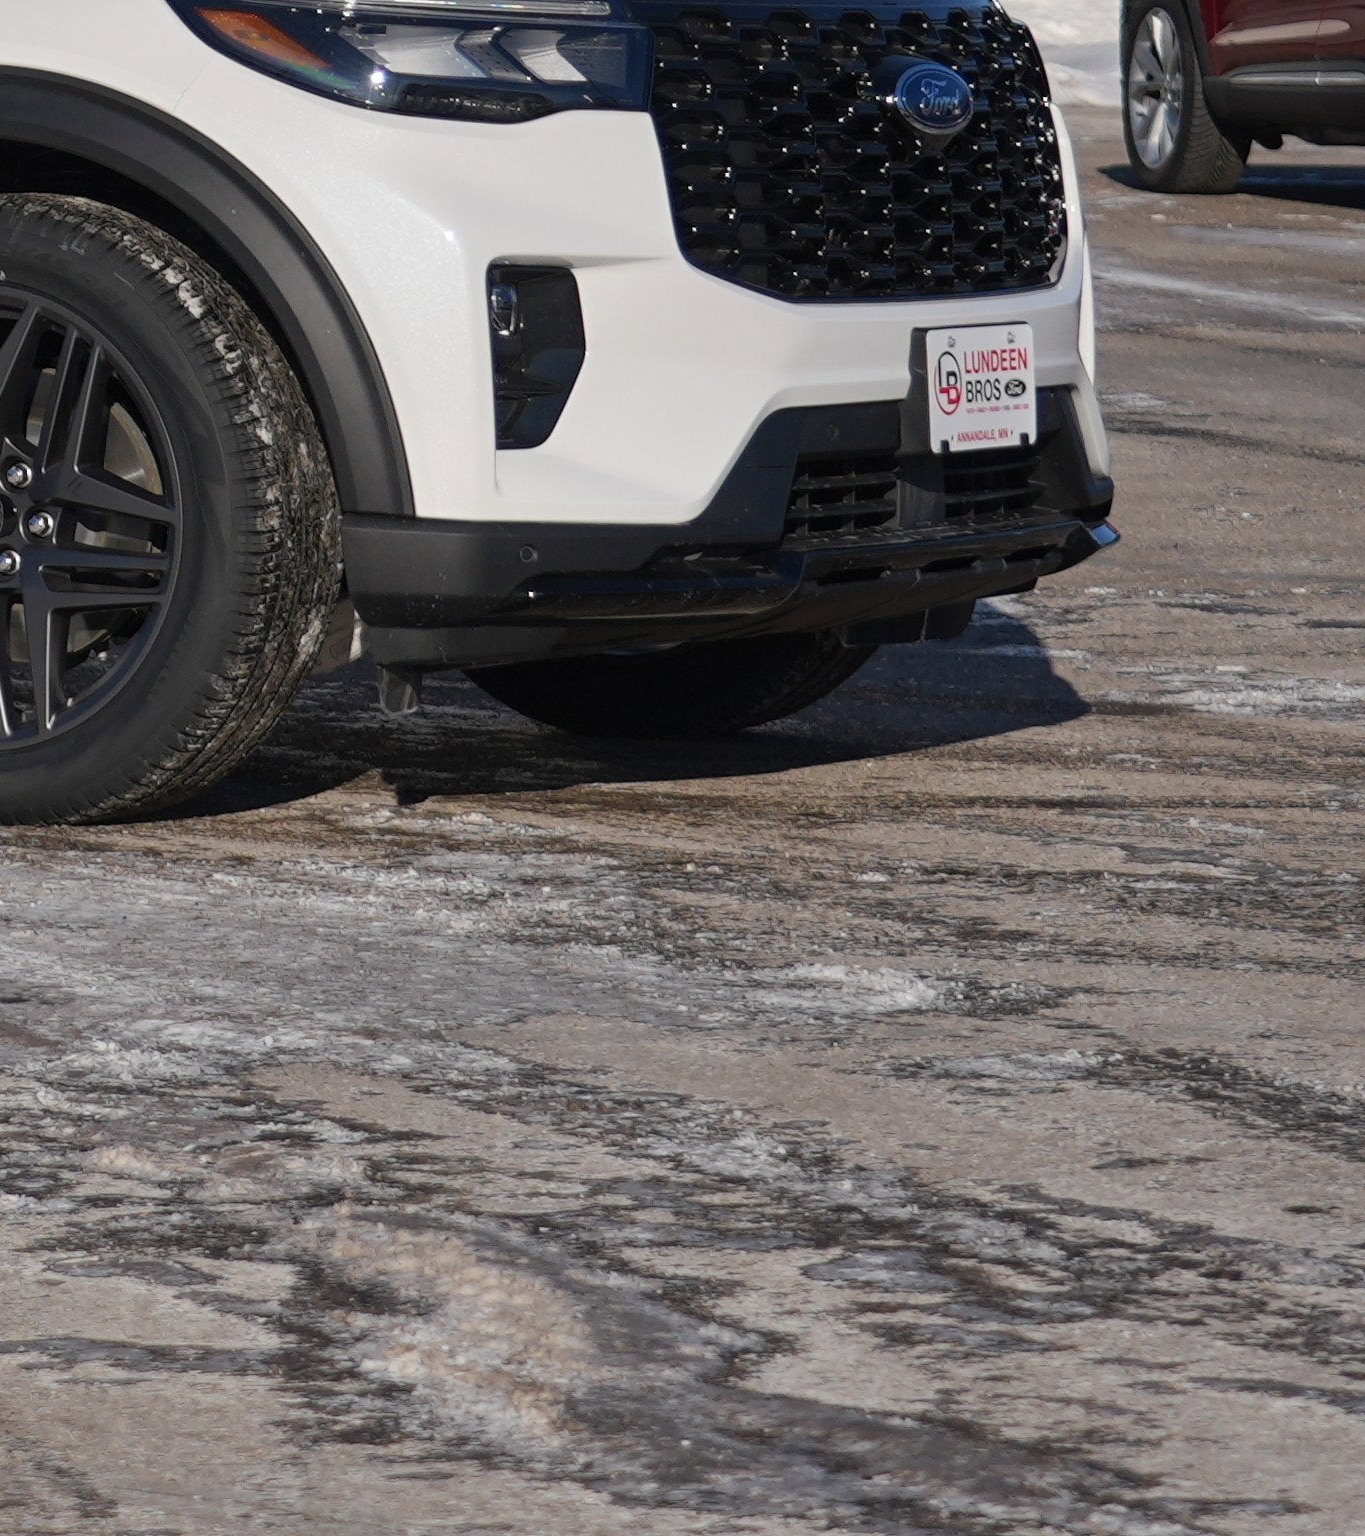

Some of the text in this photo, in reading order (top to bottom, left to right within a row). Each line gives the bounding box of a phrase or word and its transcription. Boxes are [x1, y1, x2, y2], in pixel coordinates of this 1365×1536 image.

[919, 78, 961, 116] Ford
[963, 348, 1028, 374] LUNDEEN
[966, 378, 1001, 403] BROS
